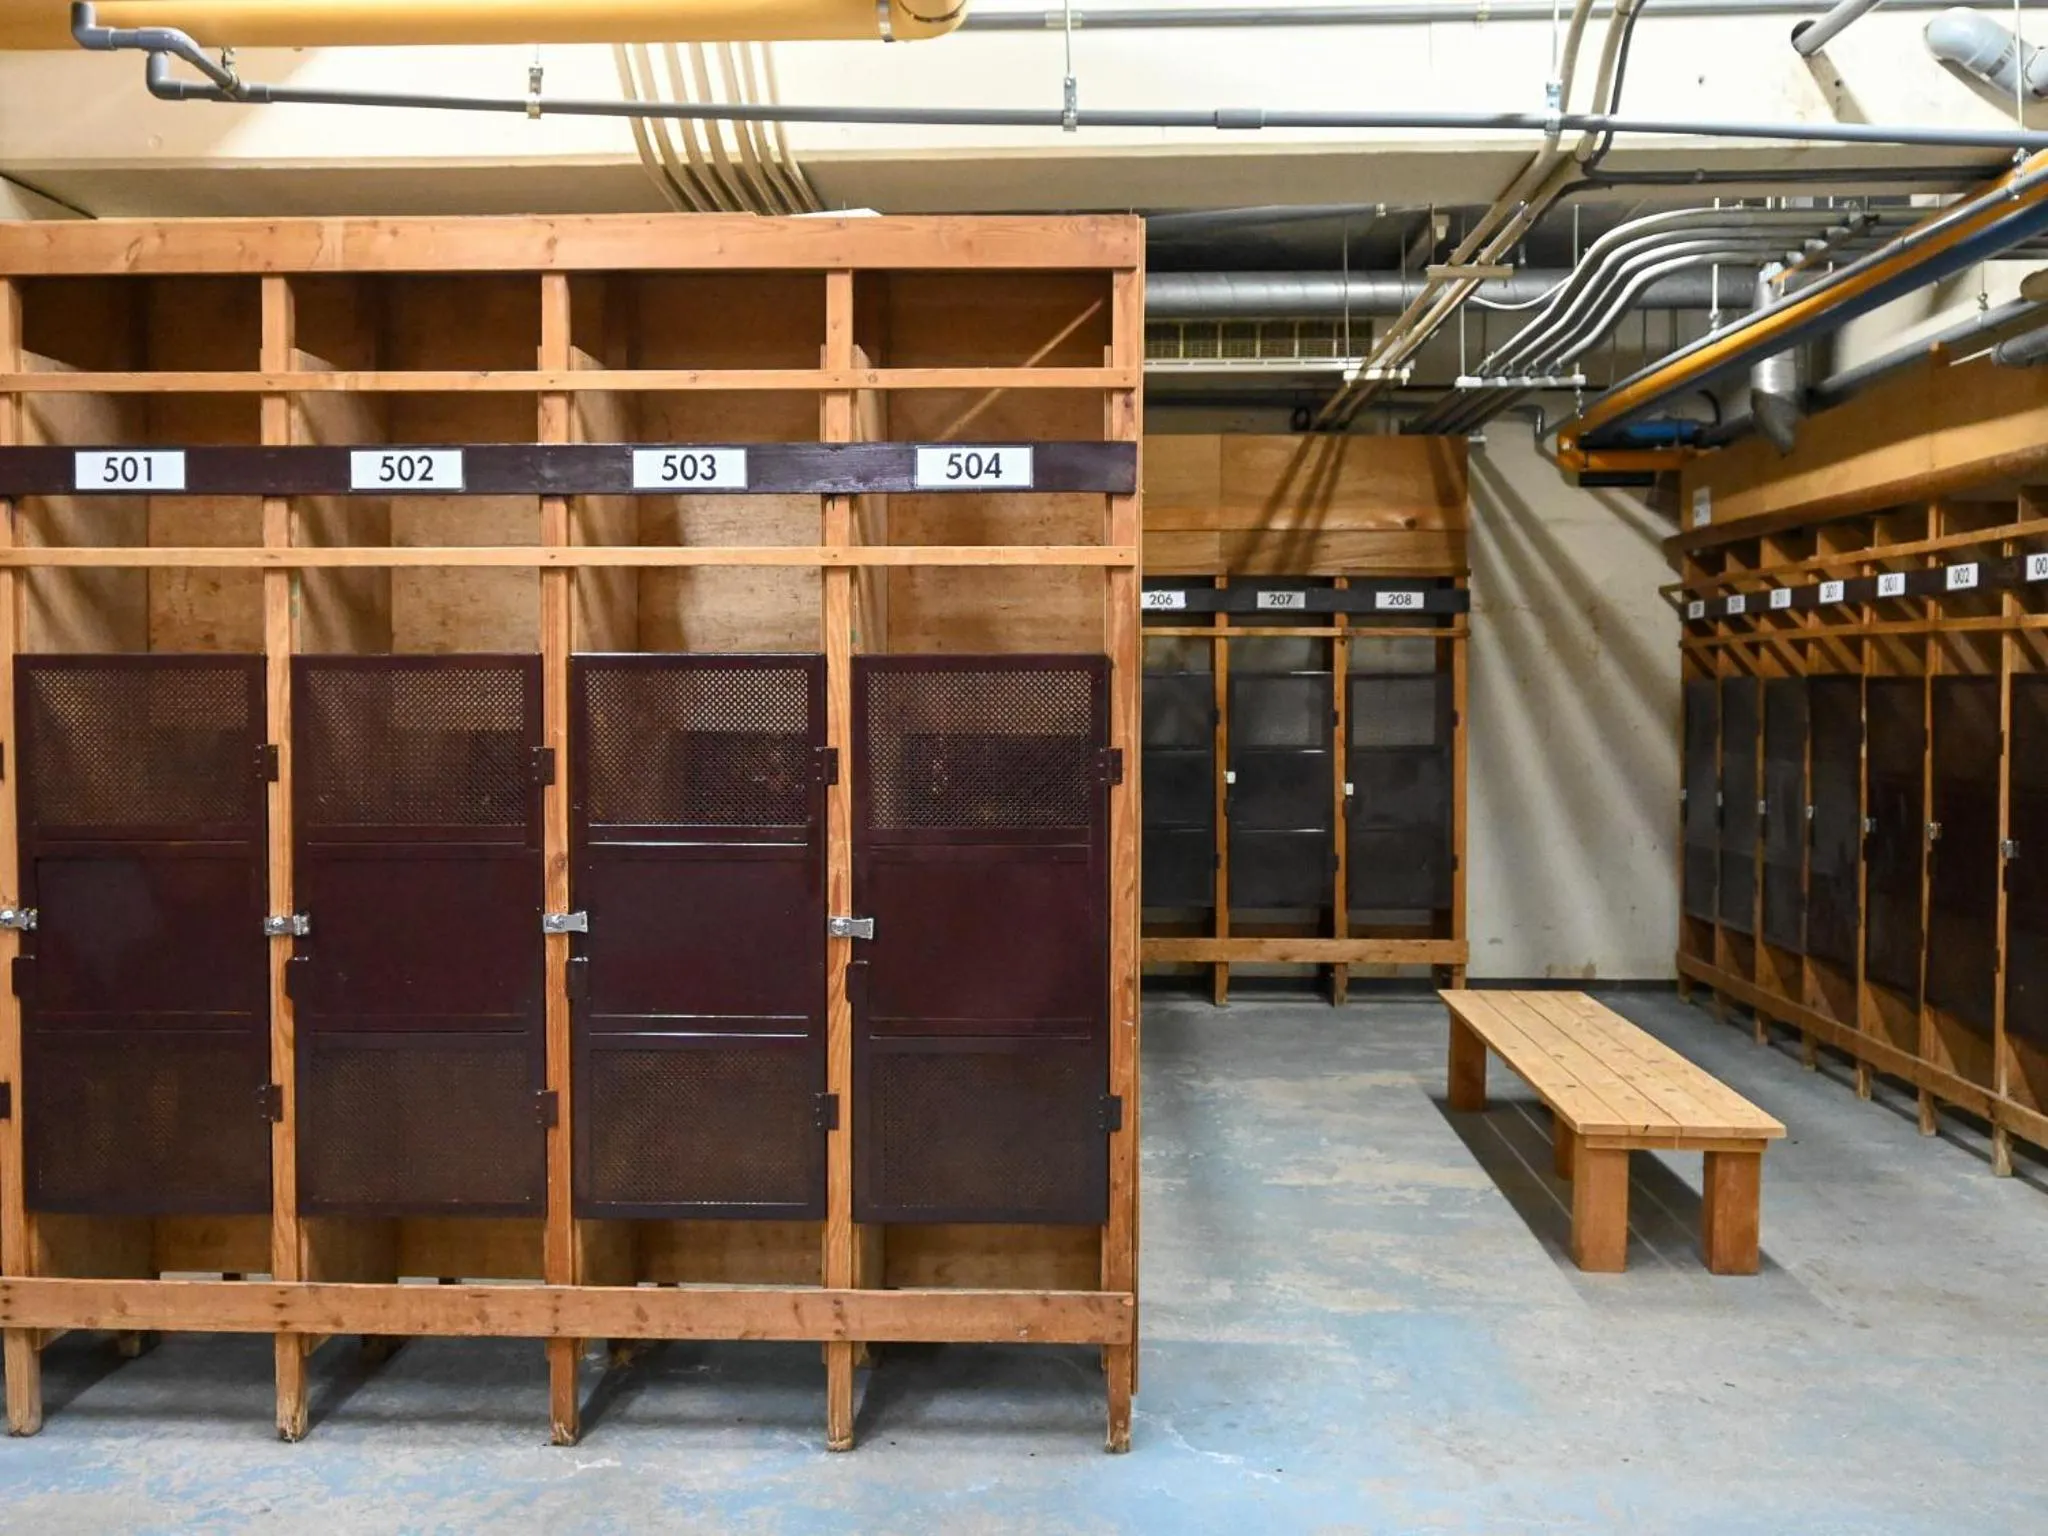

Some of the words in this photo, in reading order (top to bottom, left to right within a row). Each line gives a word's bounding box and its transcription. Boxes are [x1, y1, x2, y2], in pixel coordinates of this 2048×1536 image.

[103, 456, 153, 483] 501
[379, 455, 434, 482] 502
[661, 454, 717, 482] 503
[946, 453, 1003, 480] 504
[1149, 594, 1174, 606] 206
[1269, 594, 1294, 606] 207
[1388, 594, 1413, 606] 208
